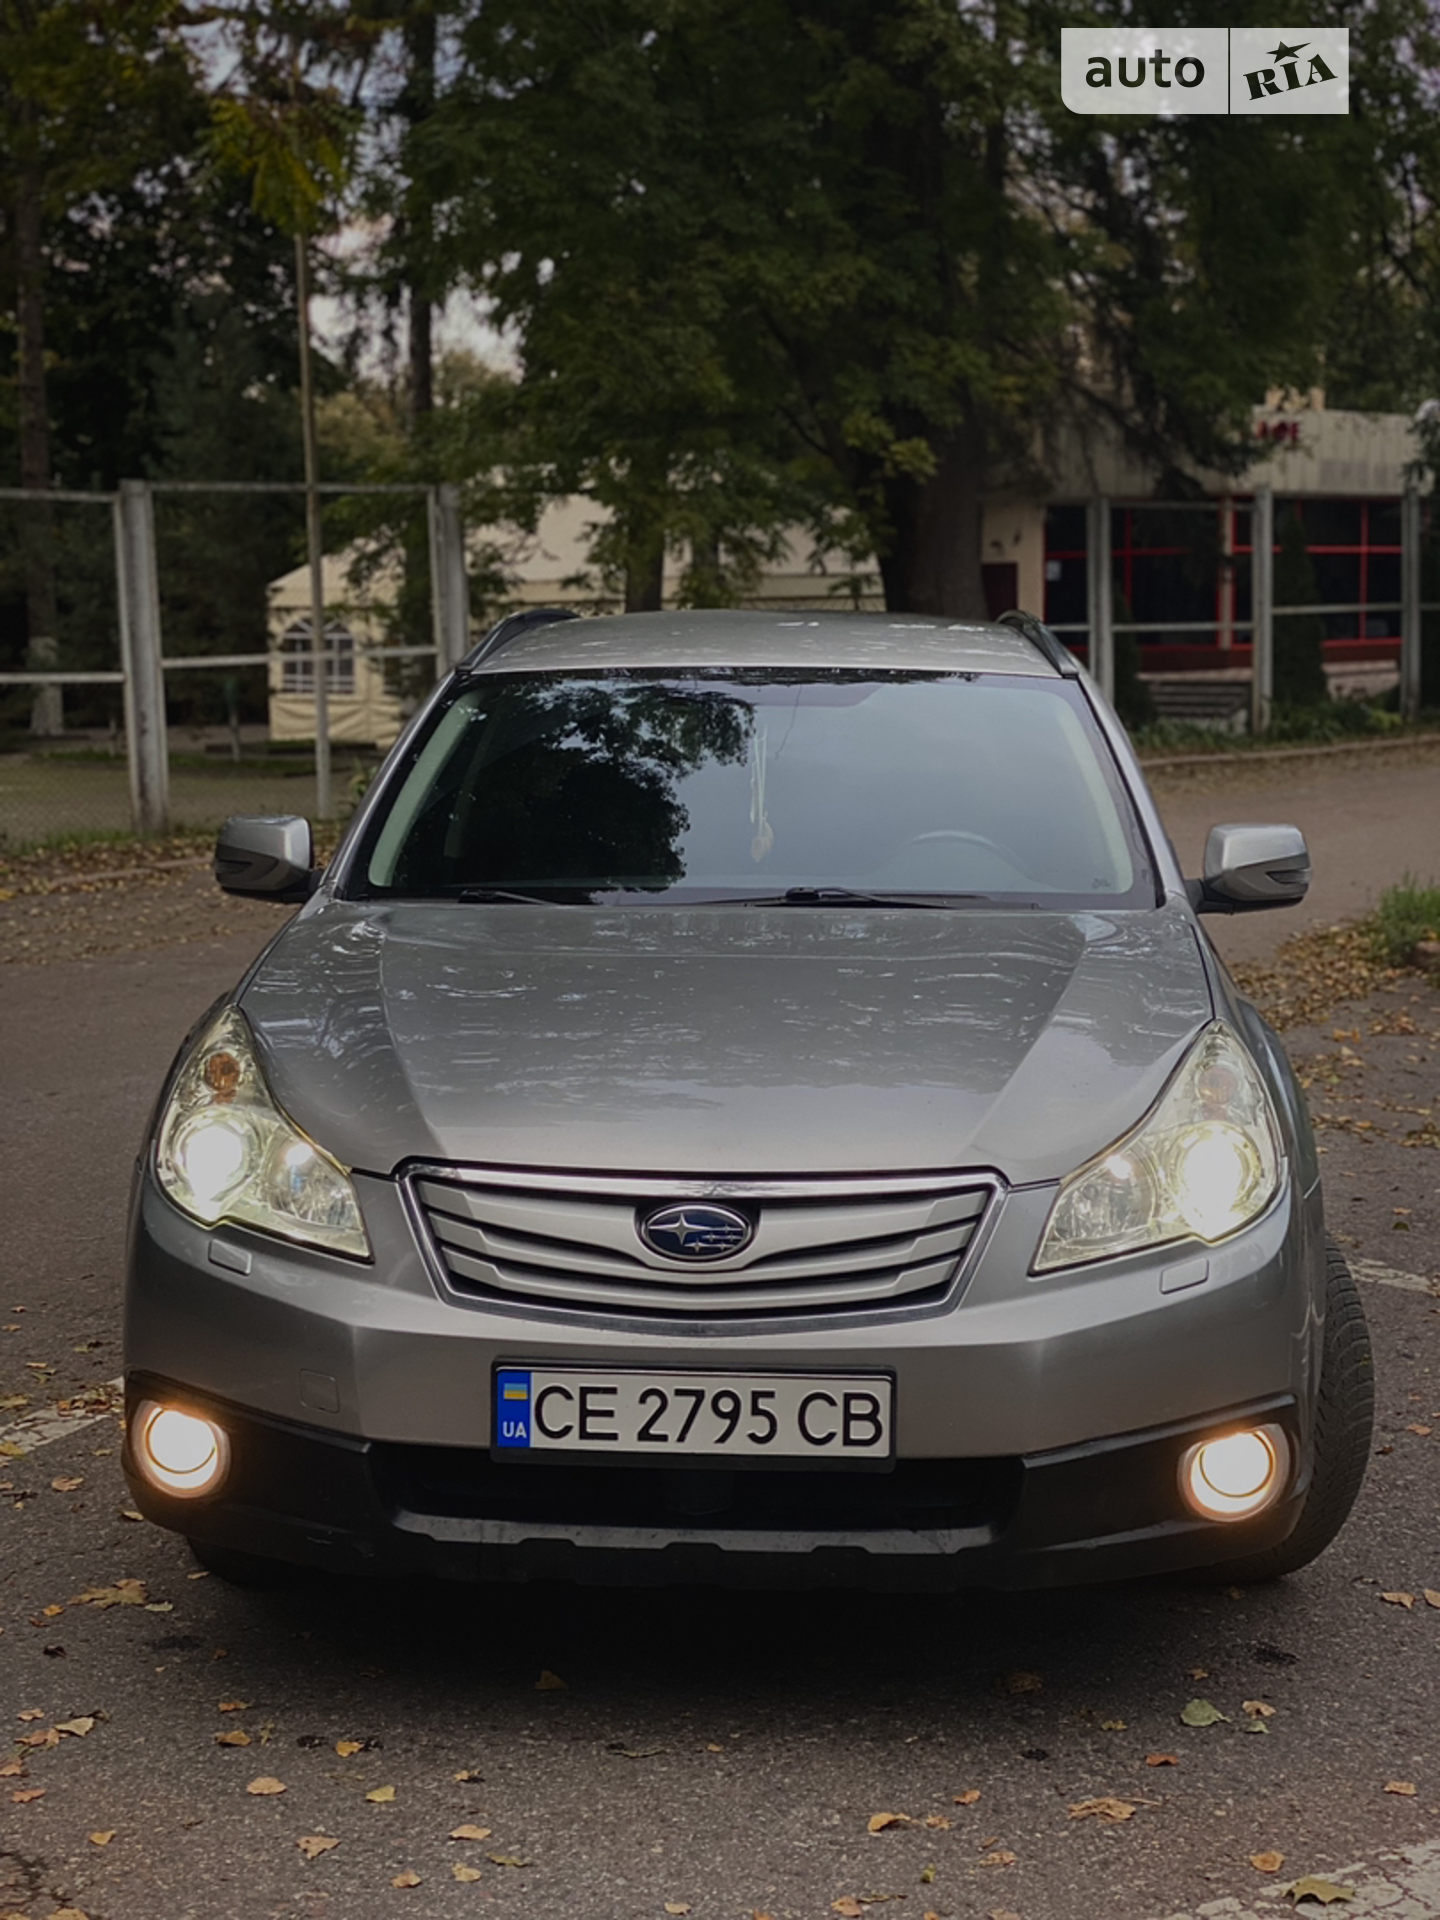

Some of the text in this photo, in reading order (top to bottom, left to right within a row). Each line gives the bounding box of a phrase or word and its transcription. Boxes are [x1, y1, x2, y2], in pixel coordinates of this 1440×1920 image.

[502, 1421, 527, 1438] UA
[534, 1385, 884, 1447] CE 2795 CB
